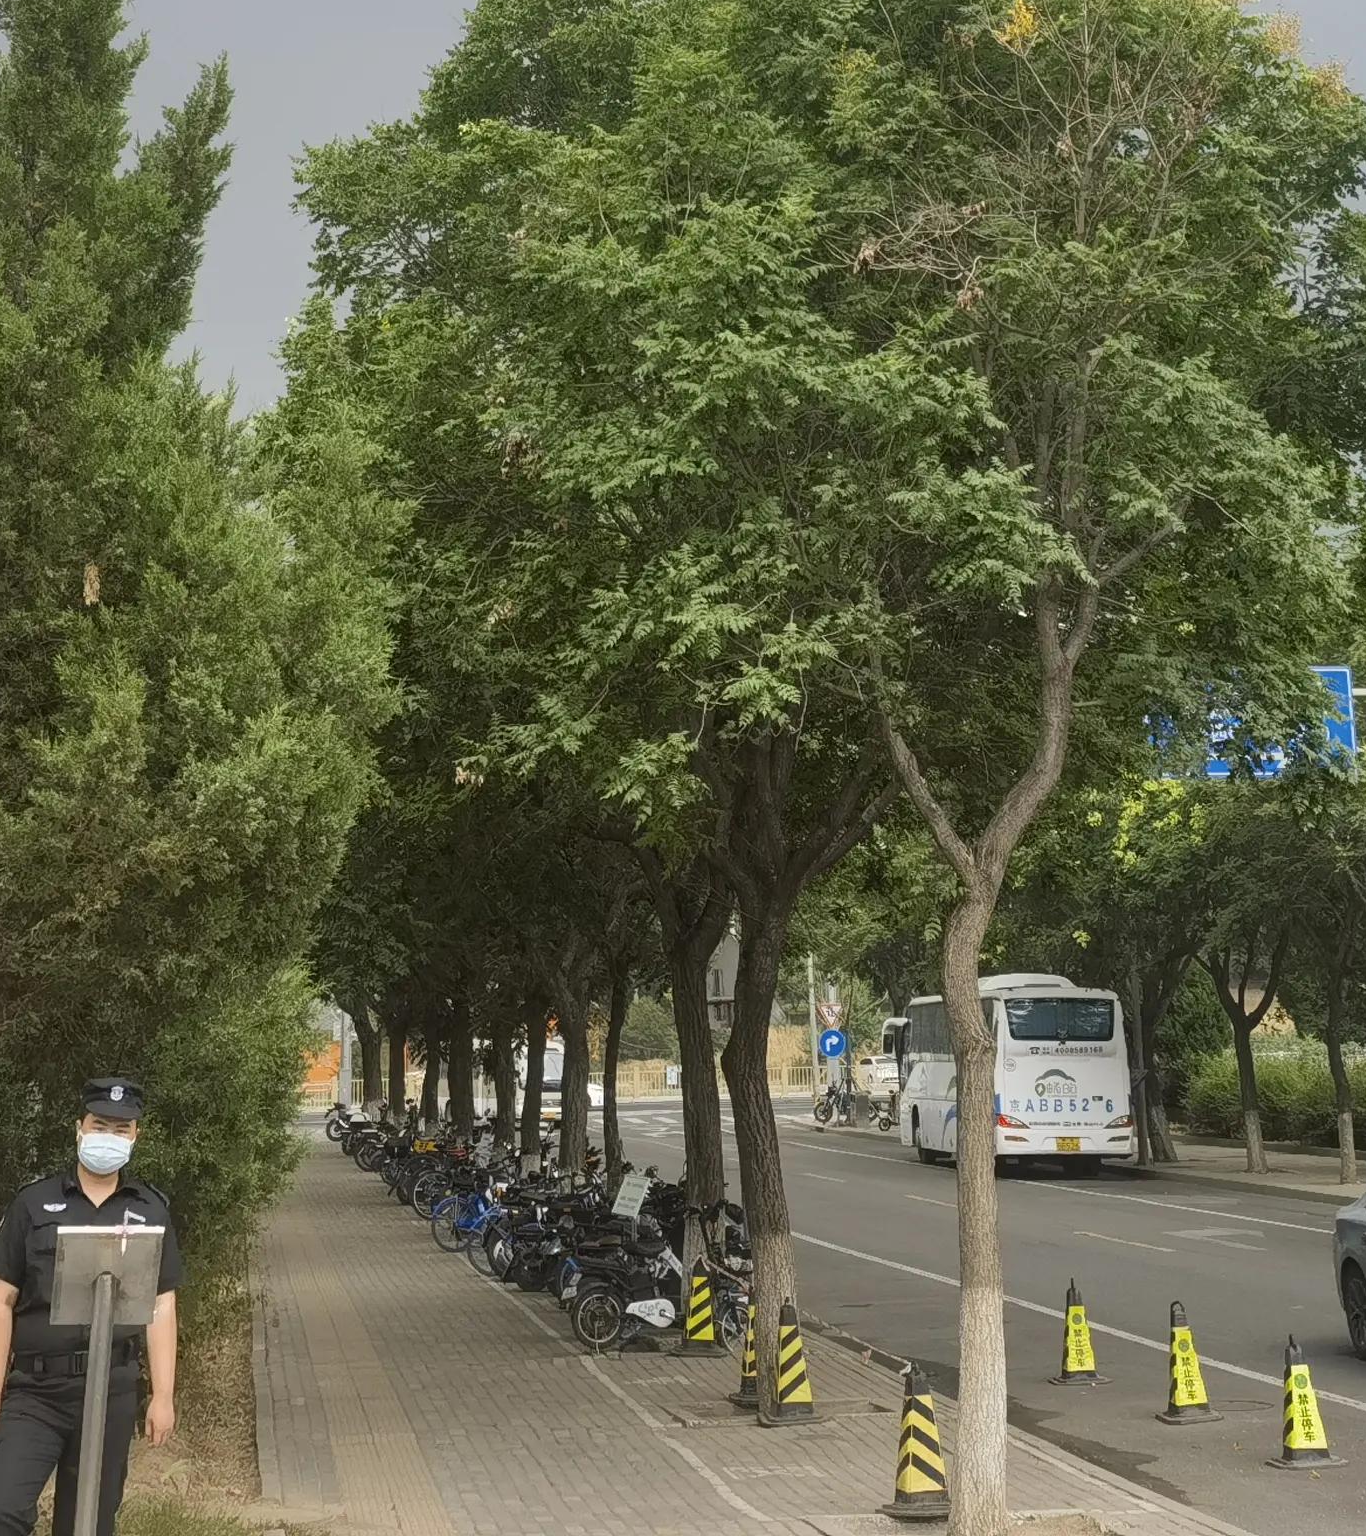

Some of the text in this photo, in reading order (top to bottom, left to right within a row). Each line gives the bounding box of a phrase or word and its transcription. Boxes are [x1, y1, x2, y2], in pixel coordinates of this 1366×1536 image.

[1073, 1329, 1085, 1367] 禁止停车
[1181, 1356, 1197, 1401] 禁止停车
[1297, 1393, 1316, 1444] 禁止停车
